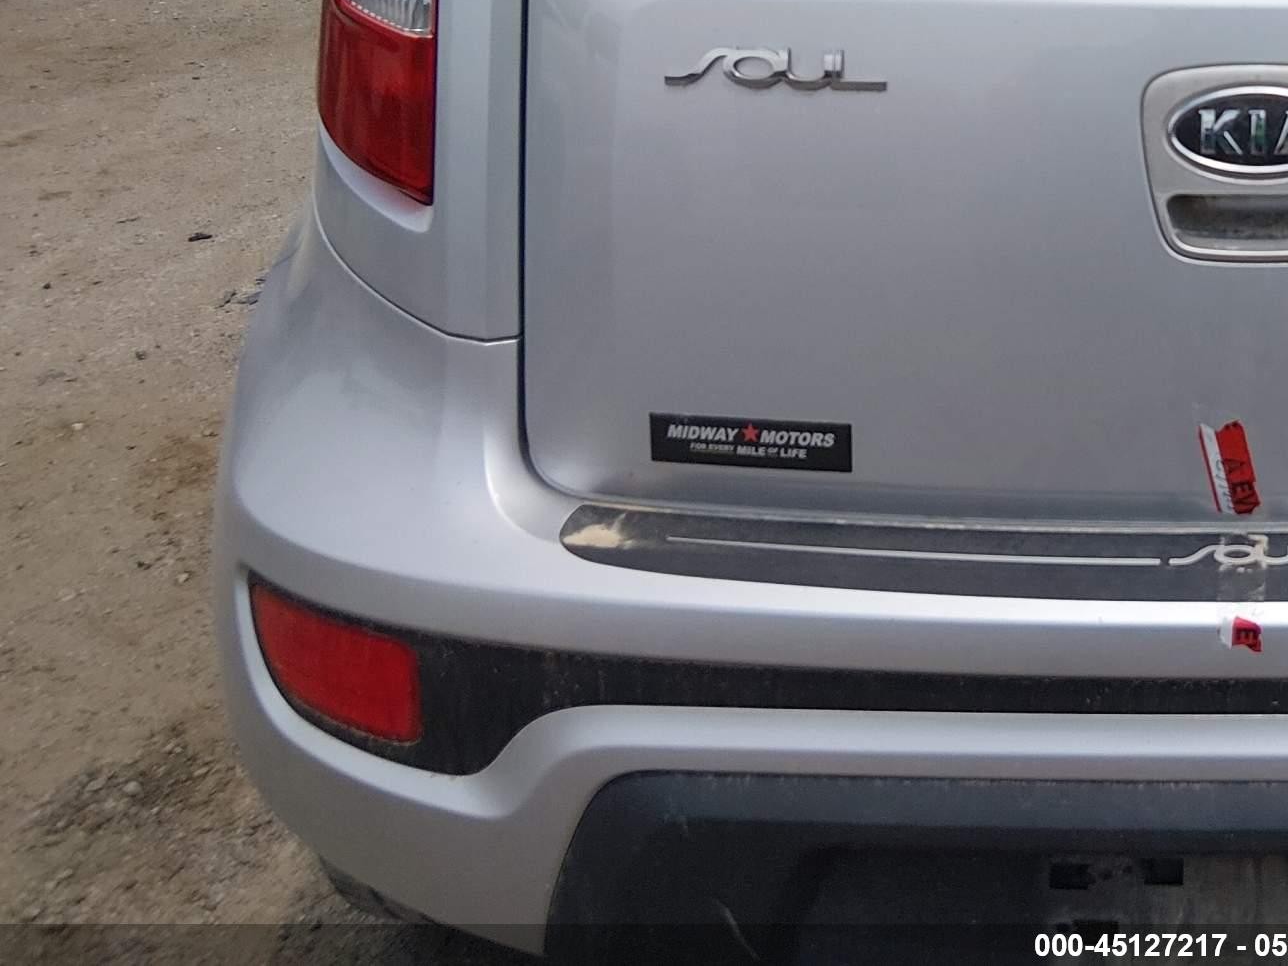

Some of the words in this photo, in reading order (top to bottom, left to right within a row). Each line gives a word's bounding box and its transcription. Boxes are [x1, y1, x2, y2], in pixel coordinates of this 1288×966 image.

[667, 425, 739, 441] MIDWAY
[759, 431, 836, 448] MOTORS
[690, 442, 707, 450] FOR
[708, 443, 735, 451] EVERY
[736, 444, 766, 457] MILE
[779, 447, 809, 460] LIFE
